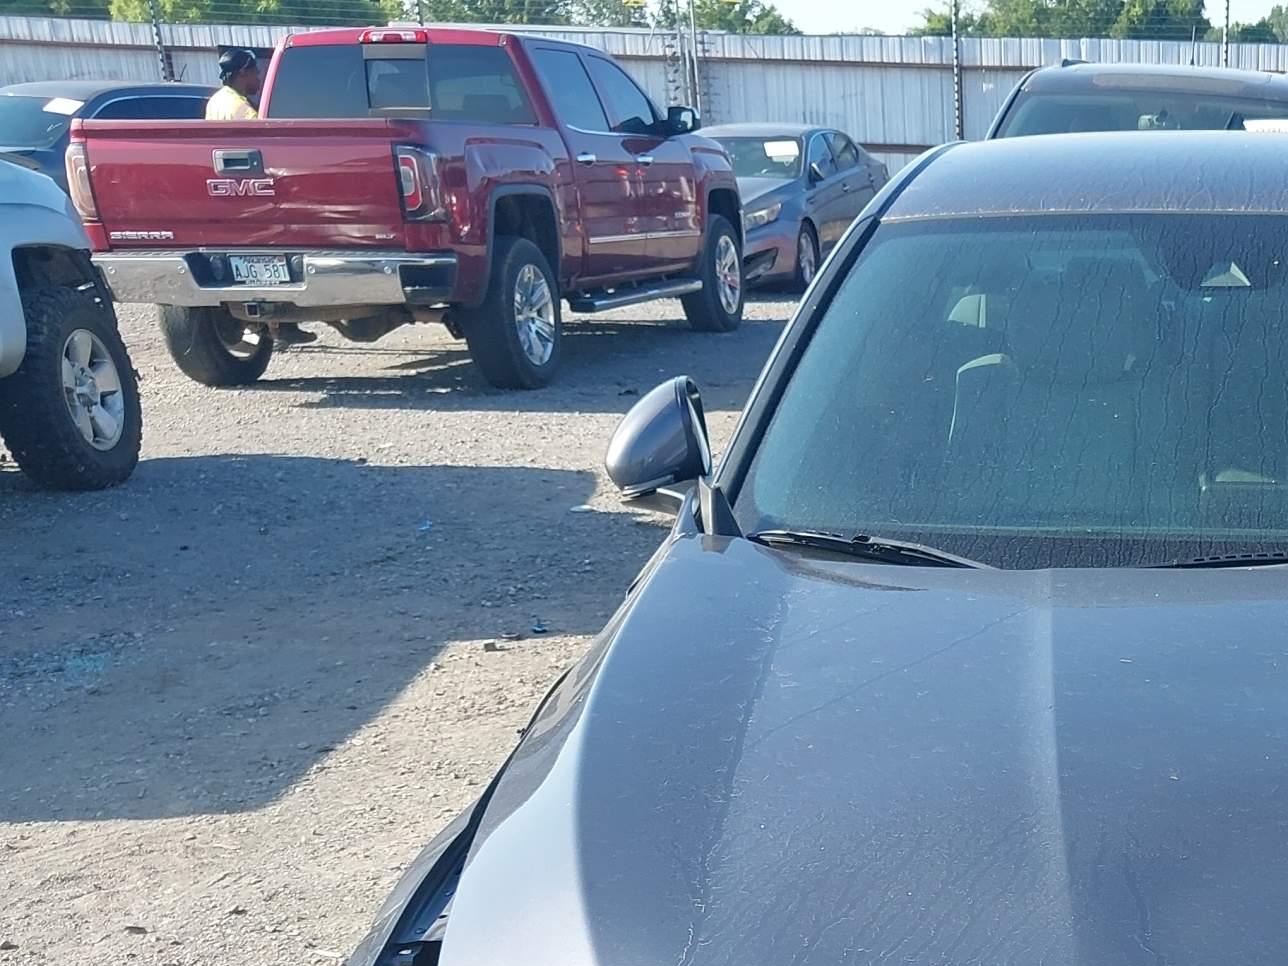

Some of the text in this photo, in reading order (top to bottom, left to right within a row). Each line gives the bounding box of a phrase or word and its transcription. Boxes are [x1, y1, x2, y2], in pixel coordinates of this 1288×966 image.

[206, 178, 275, 197] GMC
[110, 231, 174, 240] SIERRA
[234, 263, 258, 279] AJG
